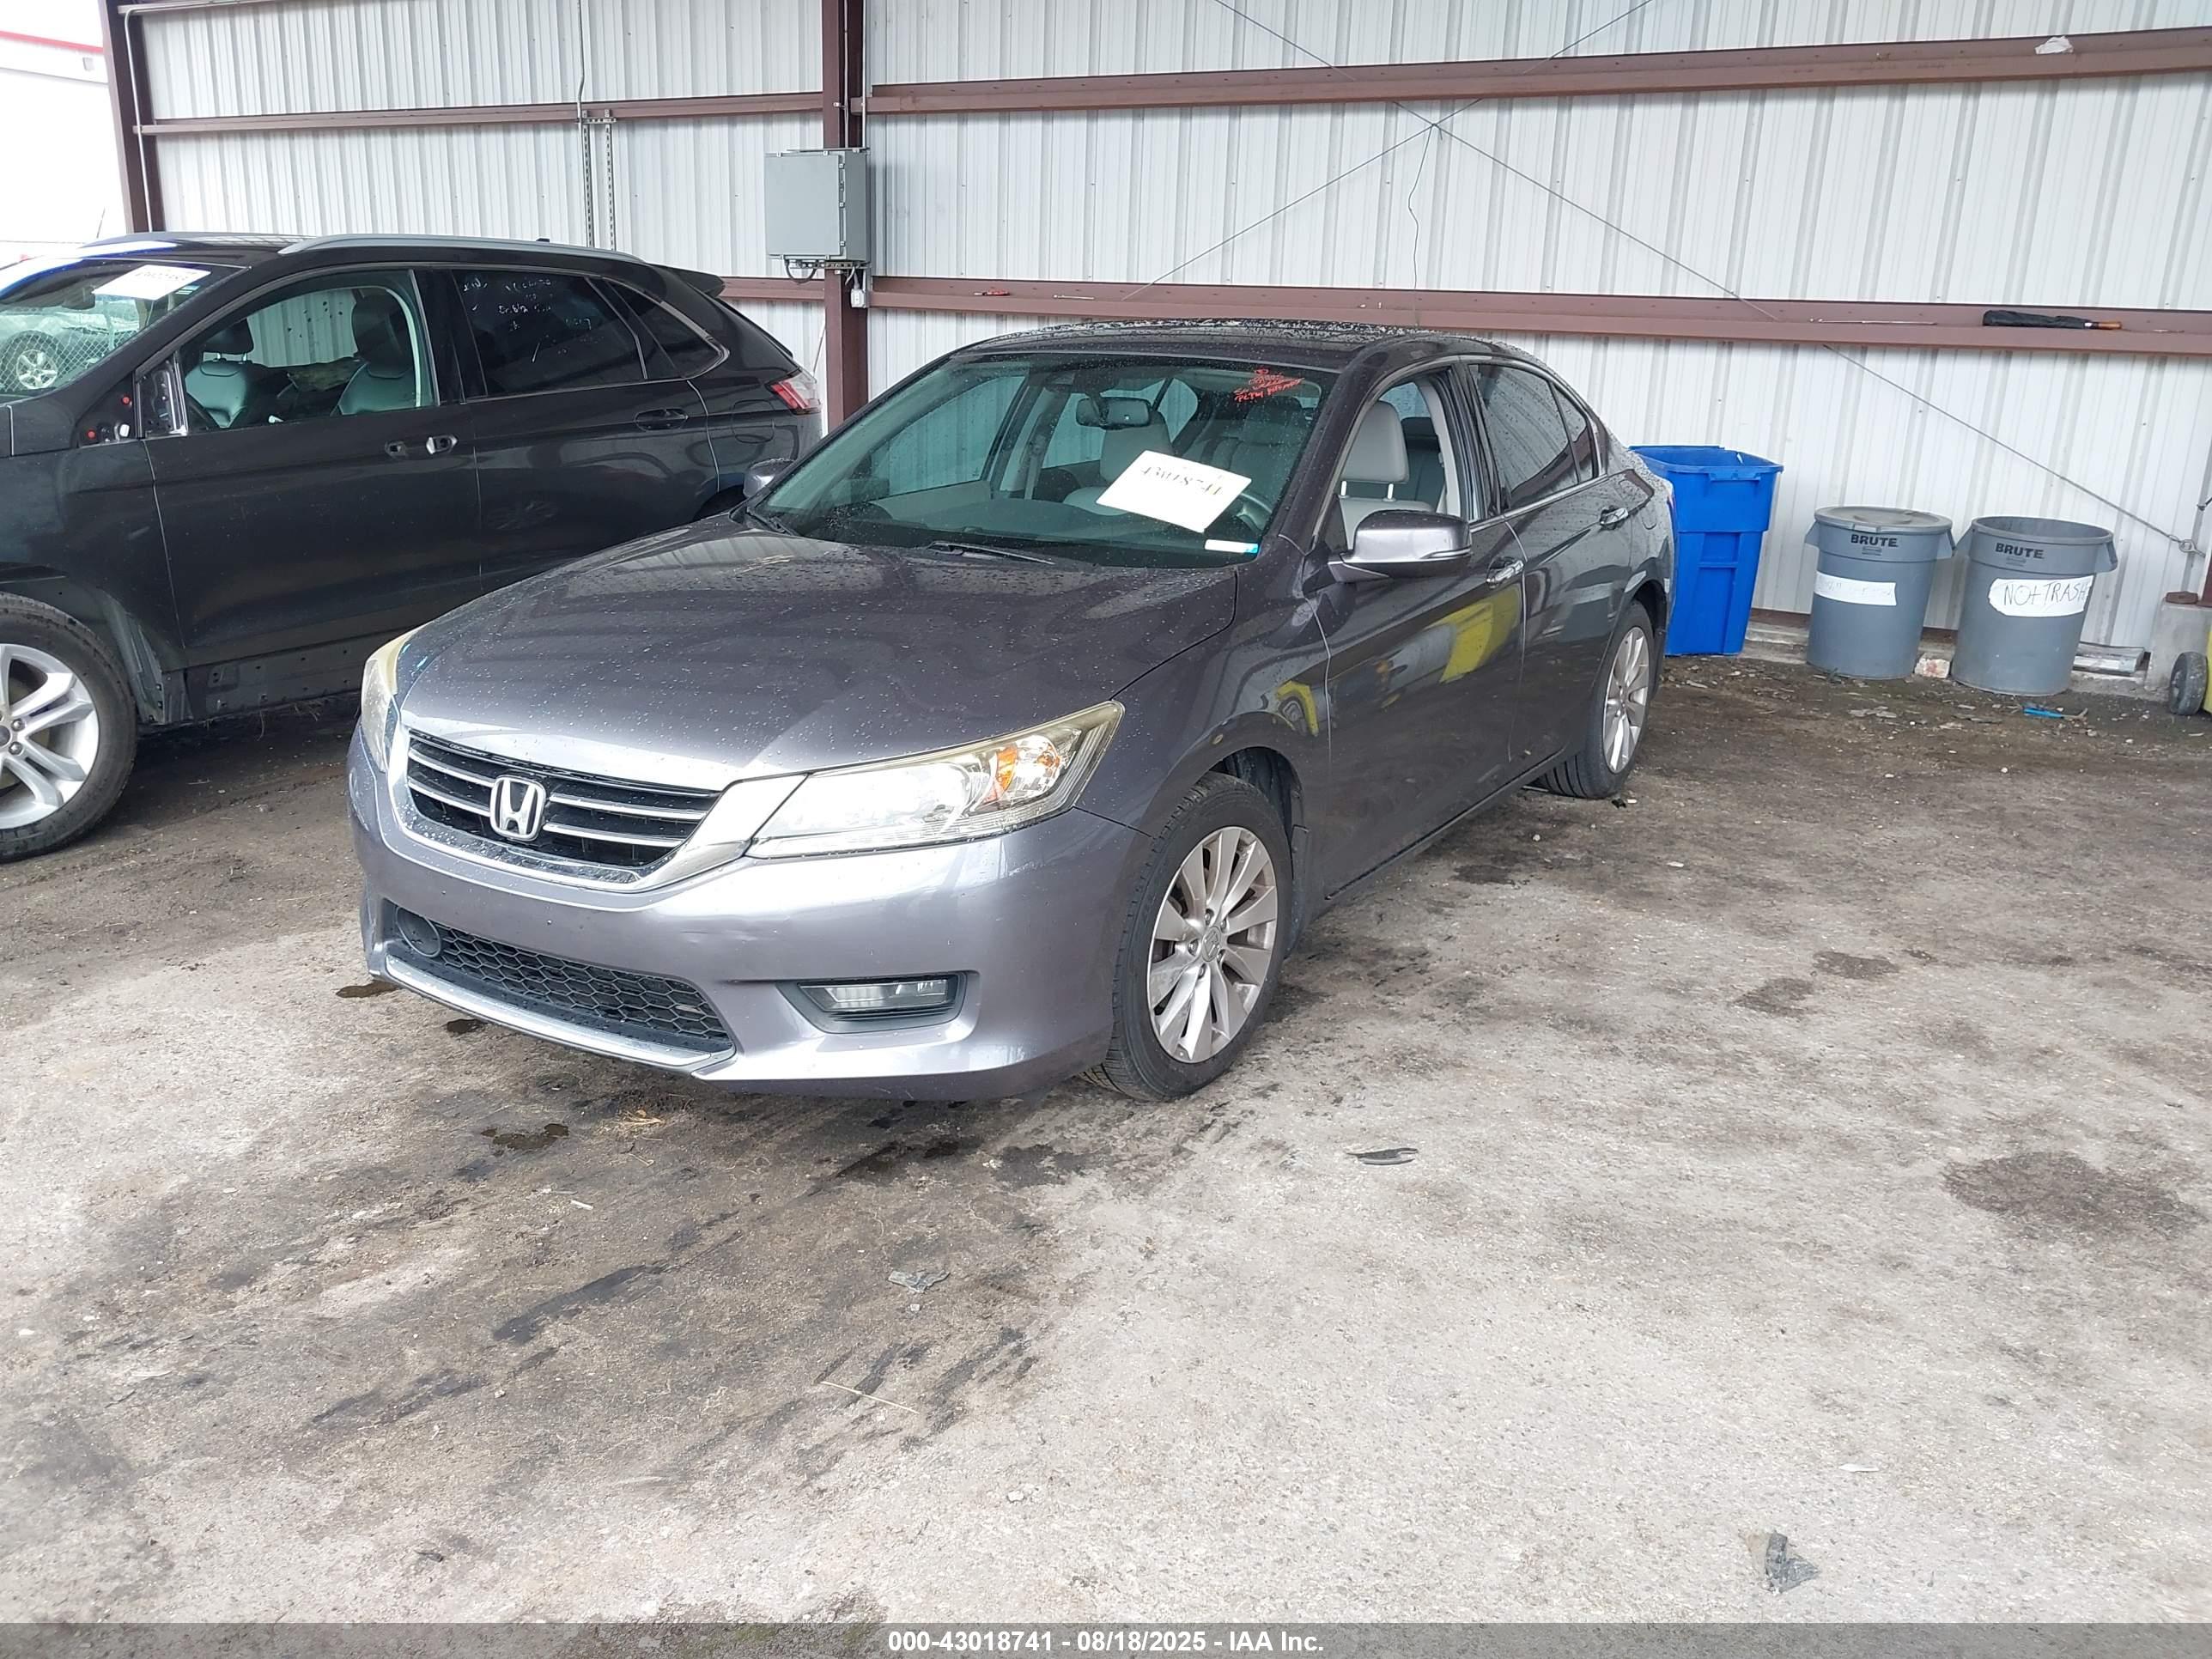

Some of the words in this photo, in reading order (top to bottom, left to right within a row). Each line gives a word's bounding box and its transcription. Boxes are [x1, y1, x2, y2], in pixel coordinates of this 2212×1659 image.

[1850, 533, 1899, 548] BRUTE
[1995, 542, 2045, 559] BRUTE
[2043, 581, 2087, 605] TRASH
